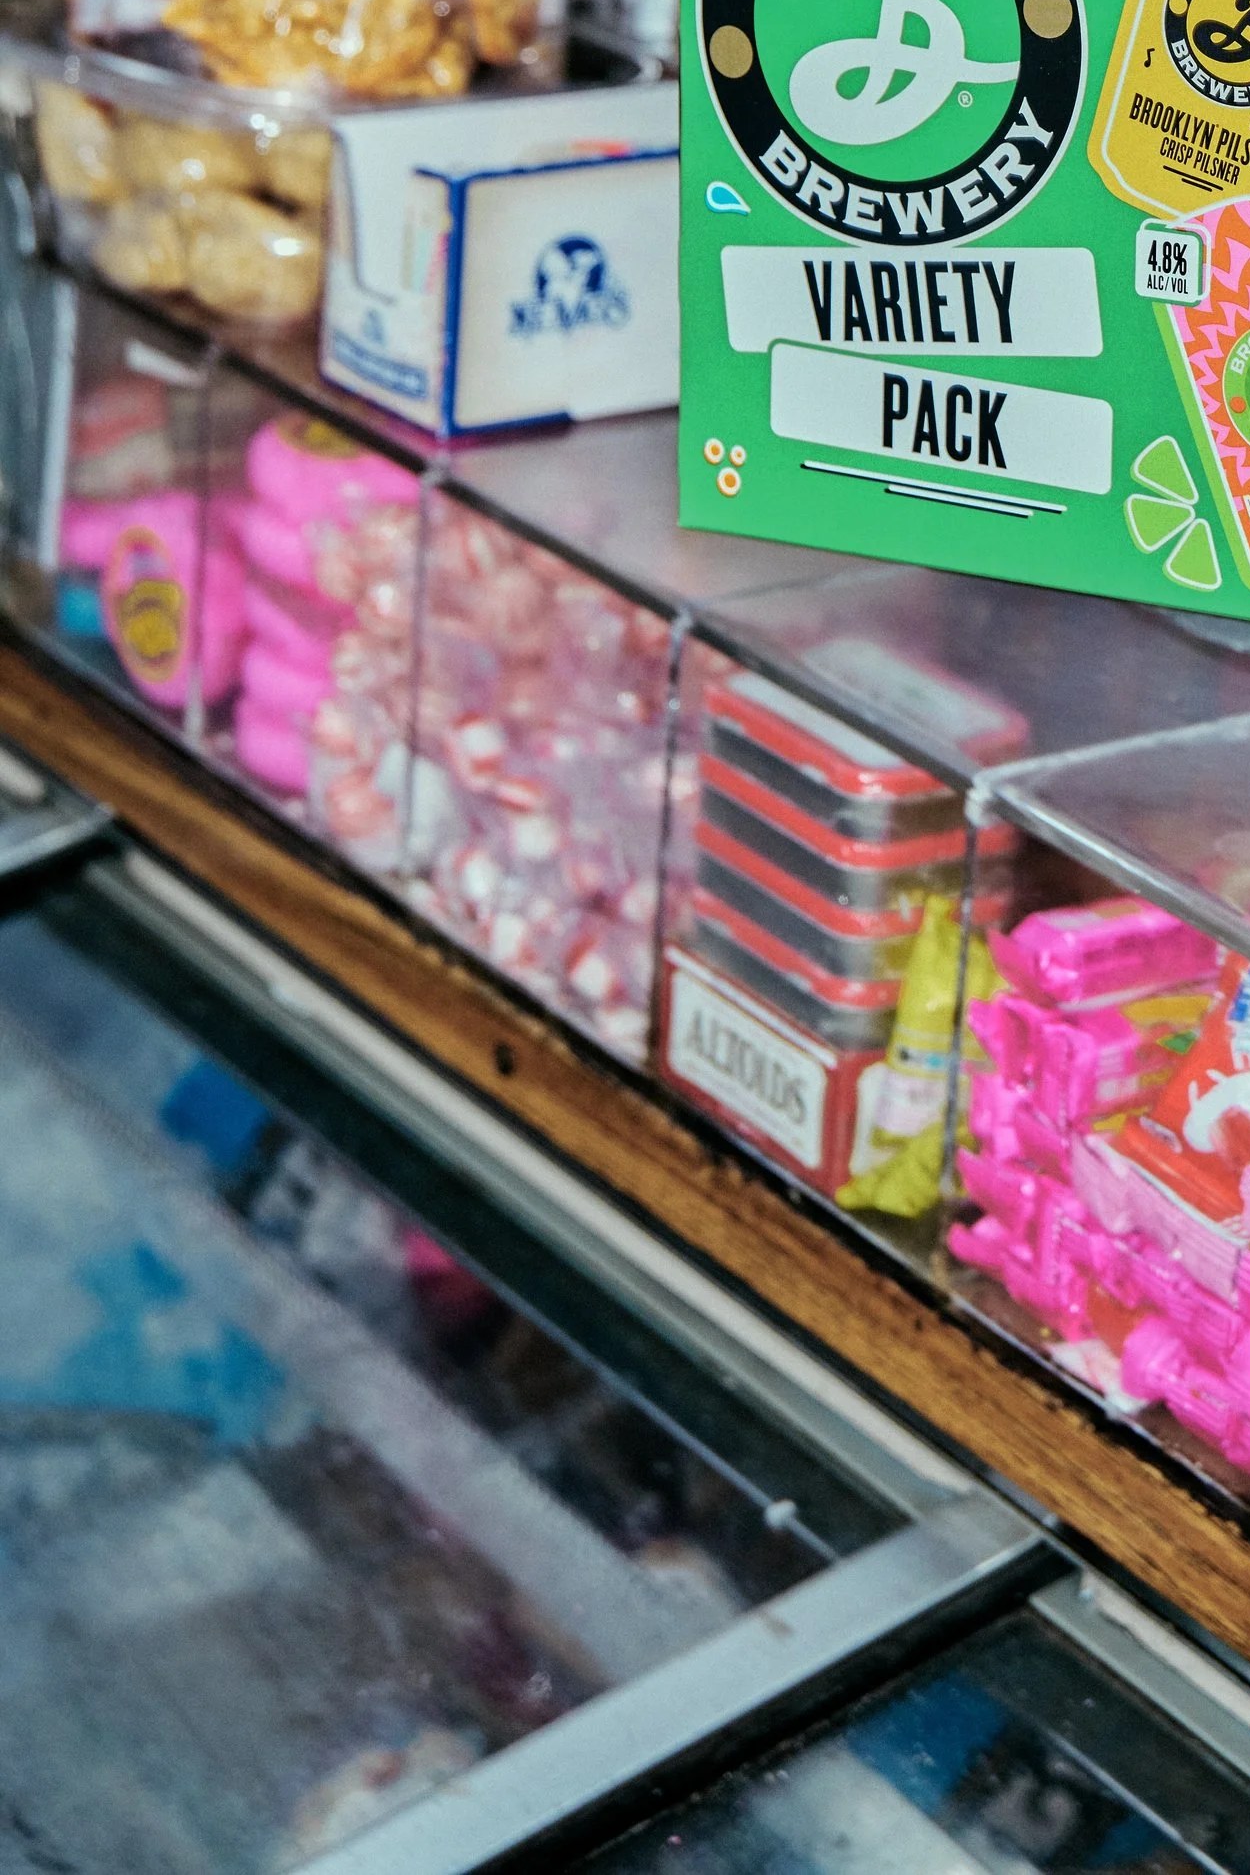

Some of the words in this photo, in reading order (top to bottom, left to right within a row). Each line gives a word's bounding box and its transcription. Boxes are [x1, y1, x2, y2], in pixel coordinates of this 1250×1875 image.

[1129, 92, 1216, 151] BROOKLYN
[759, 97, 1054, 236] BREWERY
[1159, 136, 1194, 166] CRISP
[1193, 149, 1241, 186] PILSNER
[1146, 273, 1189, 296] ALC/VOL
[1147, 240, 1188, 277] 4.8%
[803, 260, 1016, 344] VARIETY
[882, 372, 1008, 470] PACK
[685, 1011, 808, 1126] ALTOIDS
